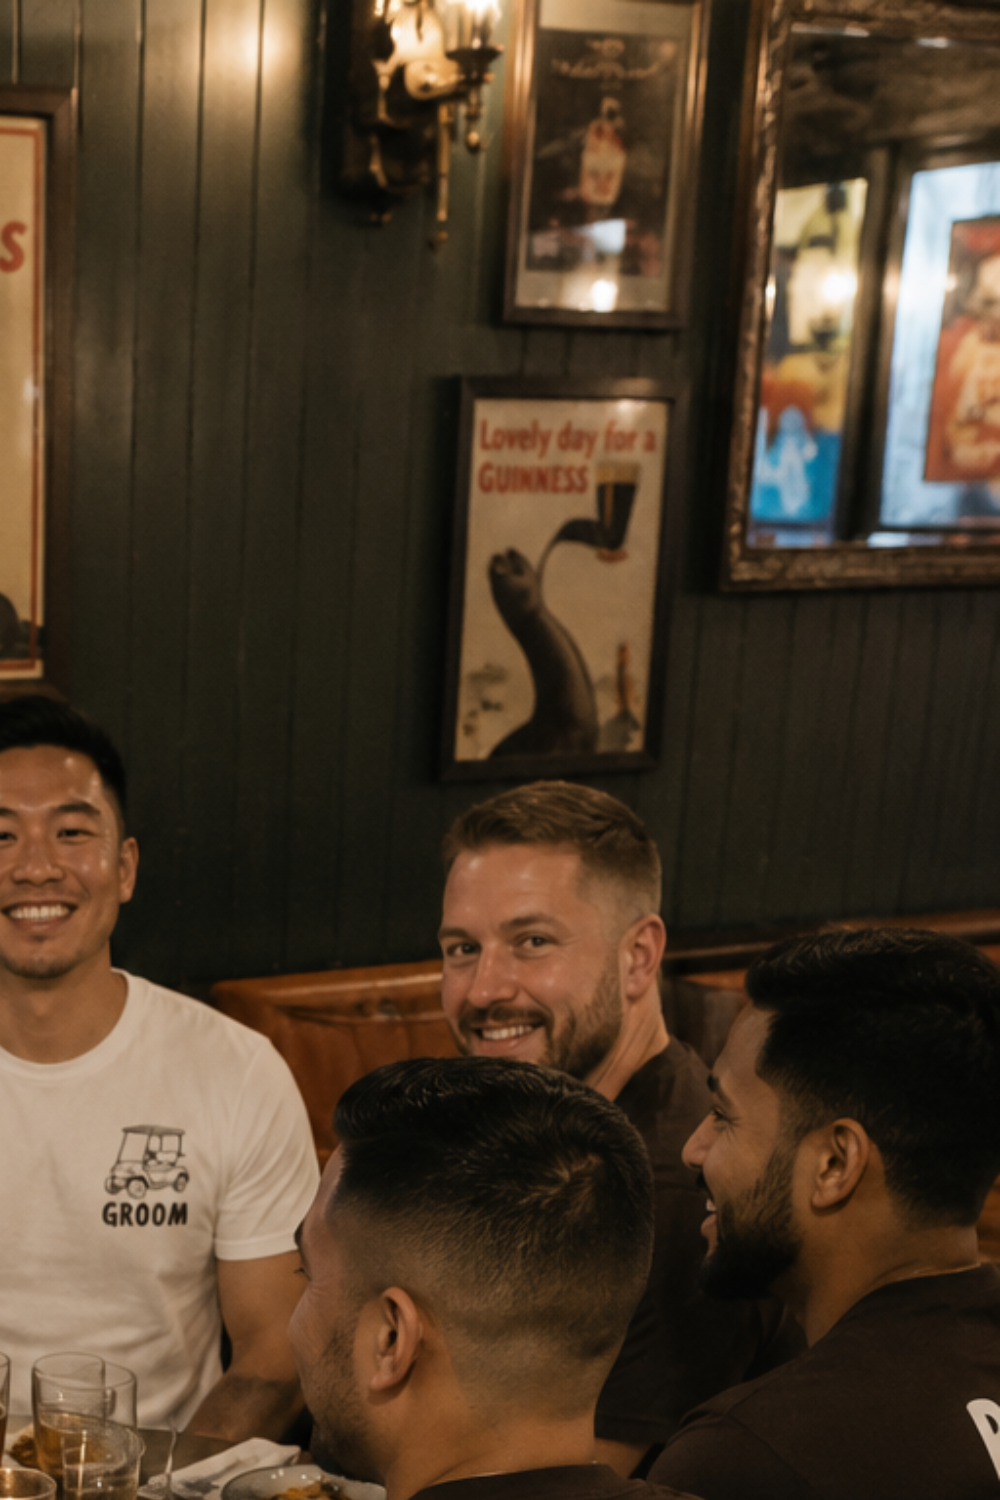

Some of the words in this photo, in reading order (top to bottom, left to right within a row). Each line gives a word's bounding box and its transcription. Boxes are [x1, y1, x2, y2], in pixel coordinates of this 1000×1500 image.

[479, 418, 551, 460] Lovely
[556, 419, 598, 460] day
[603, 419, 638, 453] for
[643, 429, 657, 453] a
[477, 461, 590, 495] GUINNESS
[101, 1201, 189, 1228] GROOM
